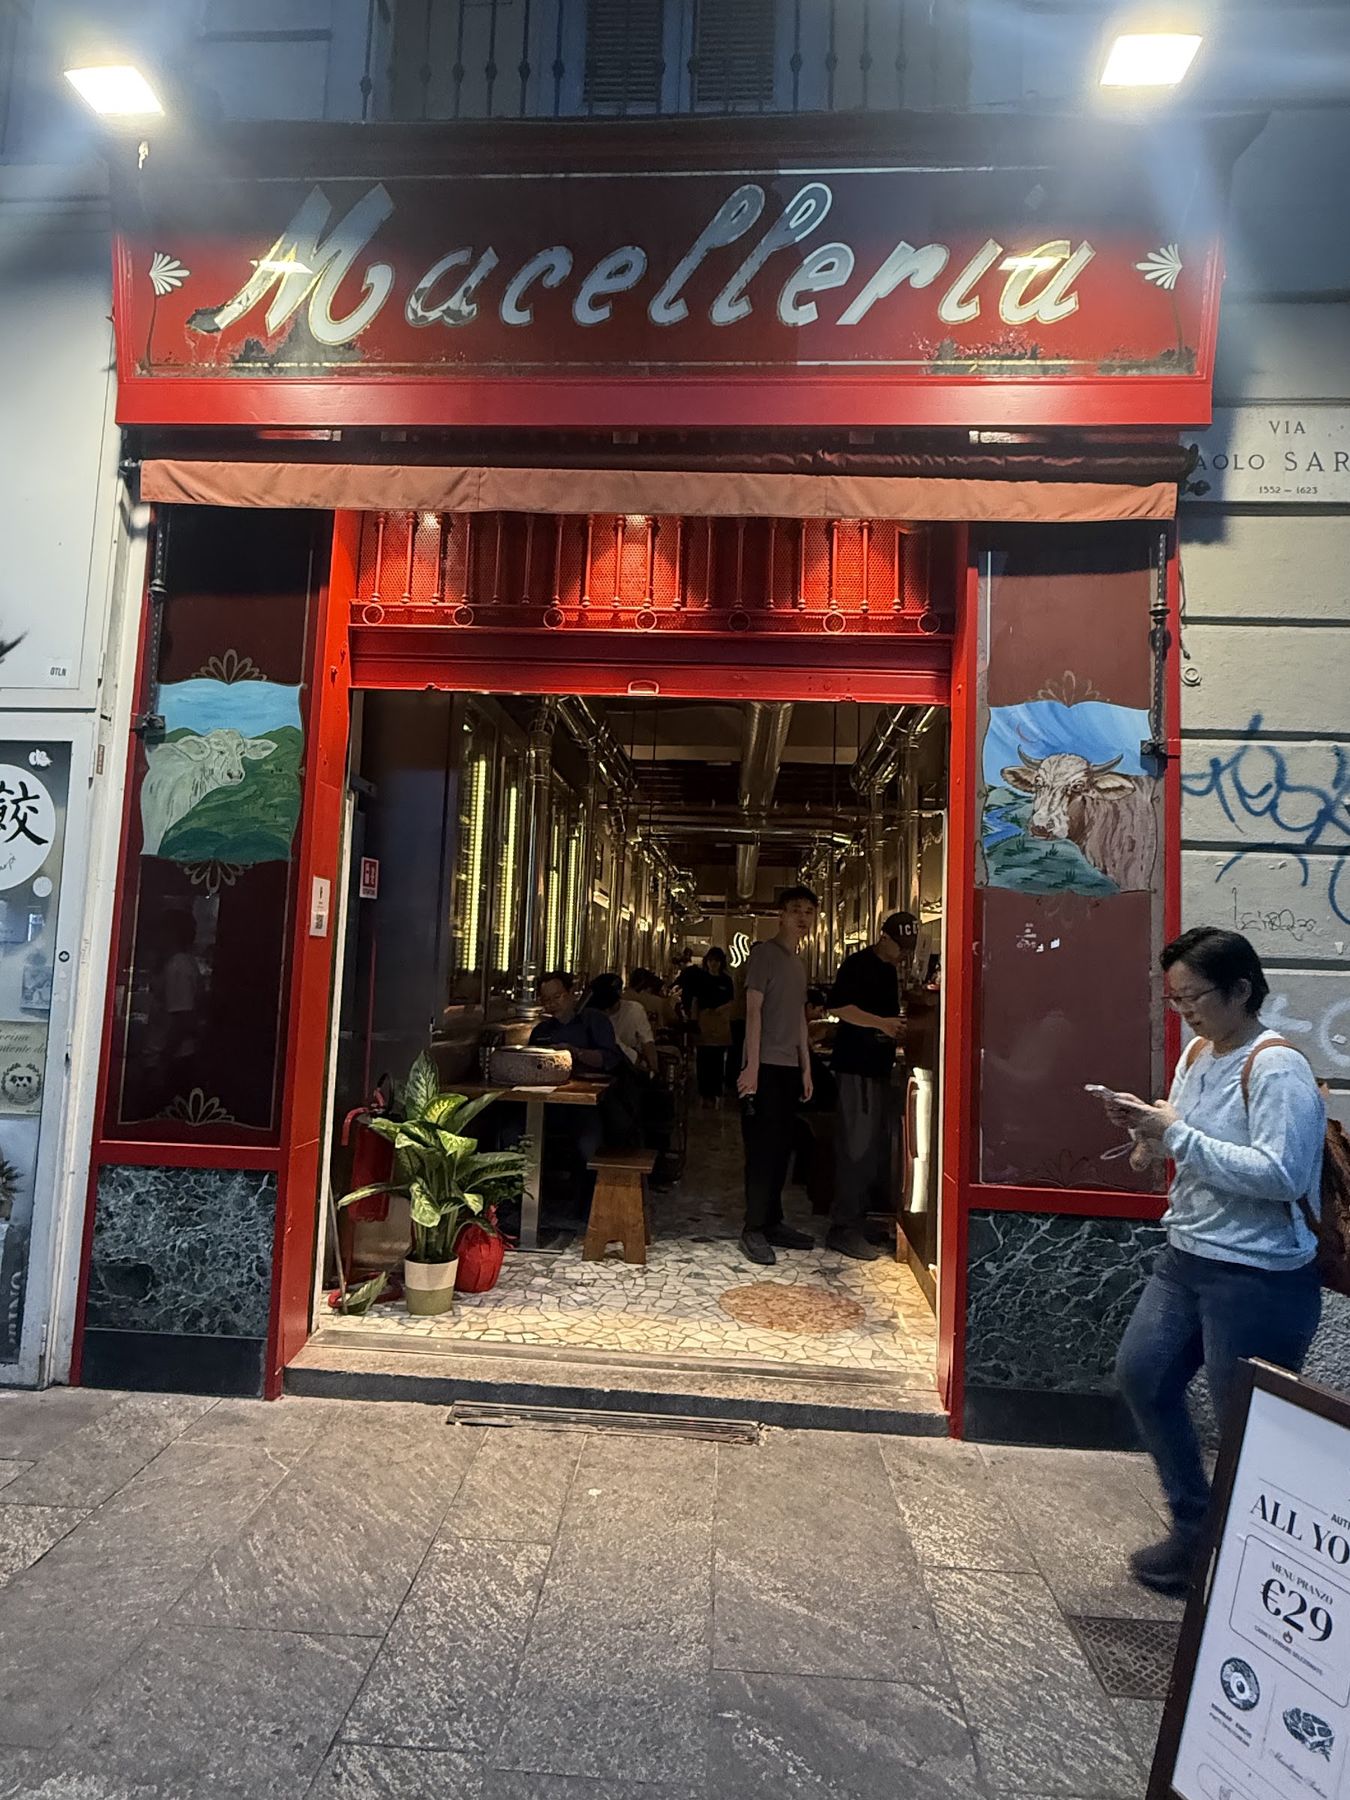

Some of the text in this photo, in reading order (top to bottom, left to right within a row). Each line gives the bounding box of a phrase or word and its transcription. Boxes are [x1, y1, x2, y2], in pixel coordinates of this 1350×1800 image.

[187, 182, 1097, 346] Macelleria
[1269, 420, 1306, 434] VIA
[1196, 454, 1265, 470] AOLO
[1259, 486, 1281, 494] 1552
[1296, 486, 1318, 494] 1623
[1250, 1494, 1350, 1565] ALL YO
[1271, 1561, 1334, 1606] MENU PRANZO
[1260, 1578, 1334, 1642] €29
